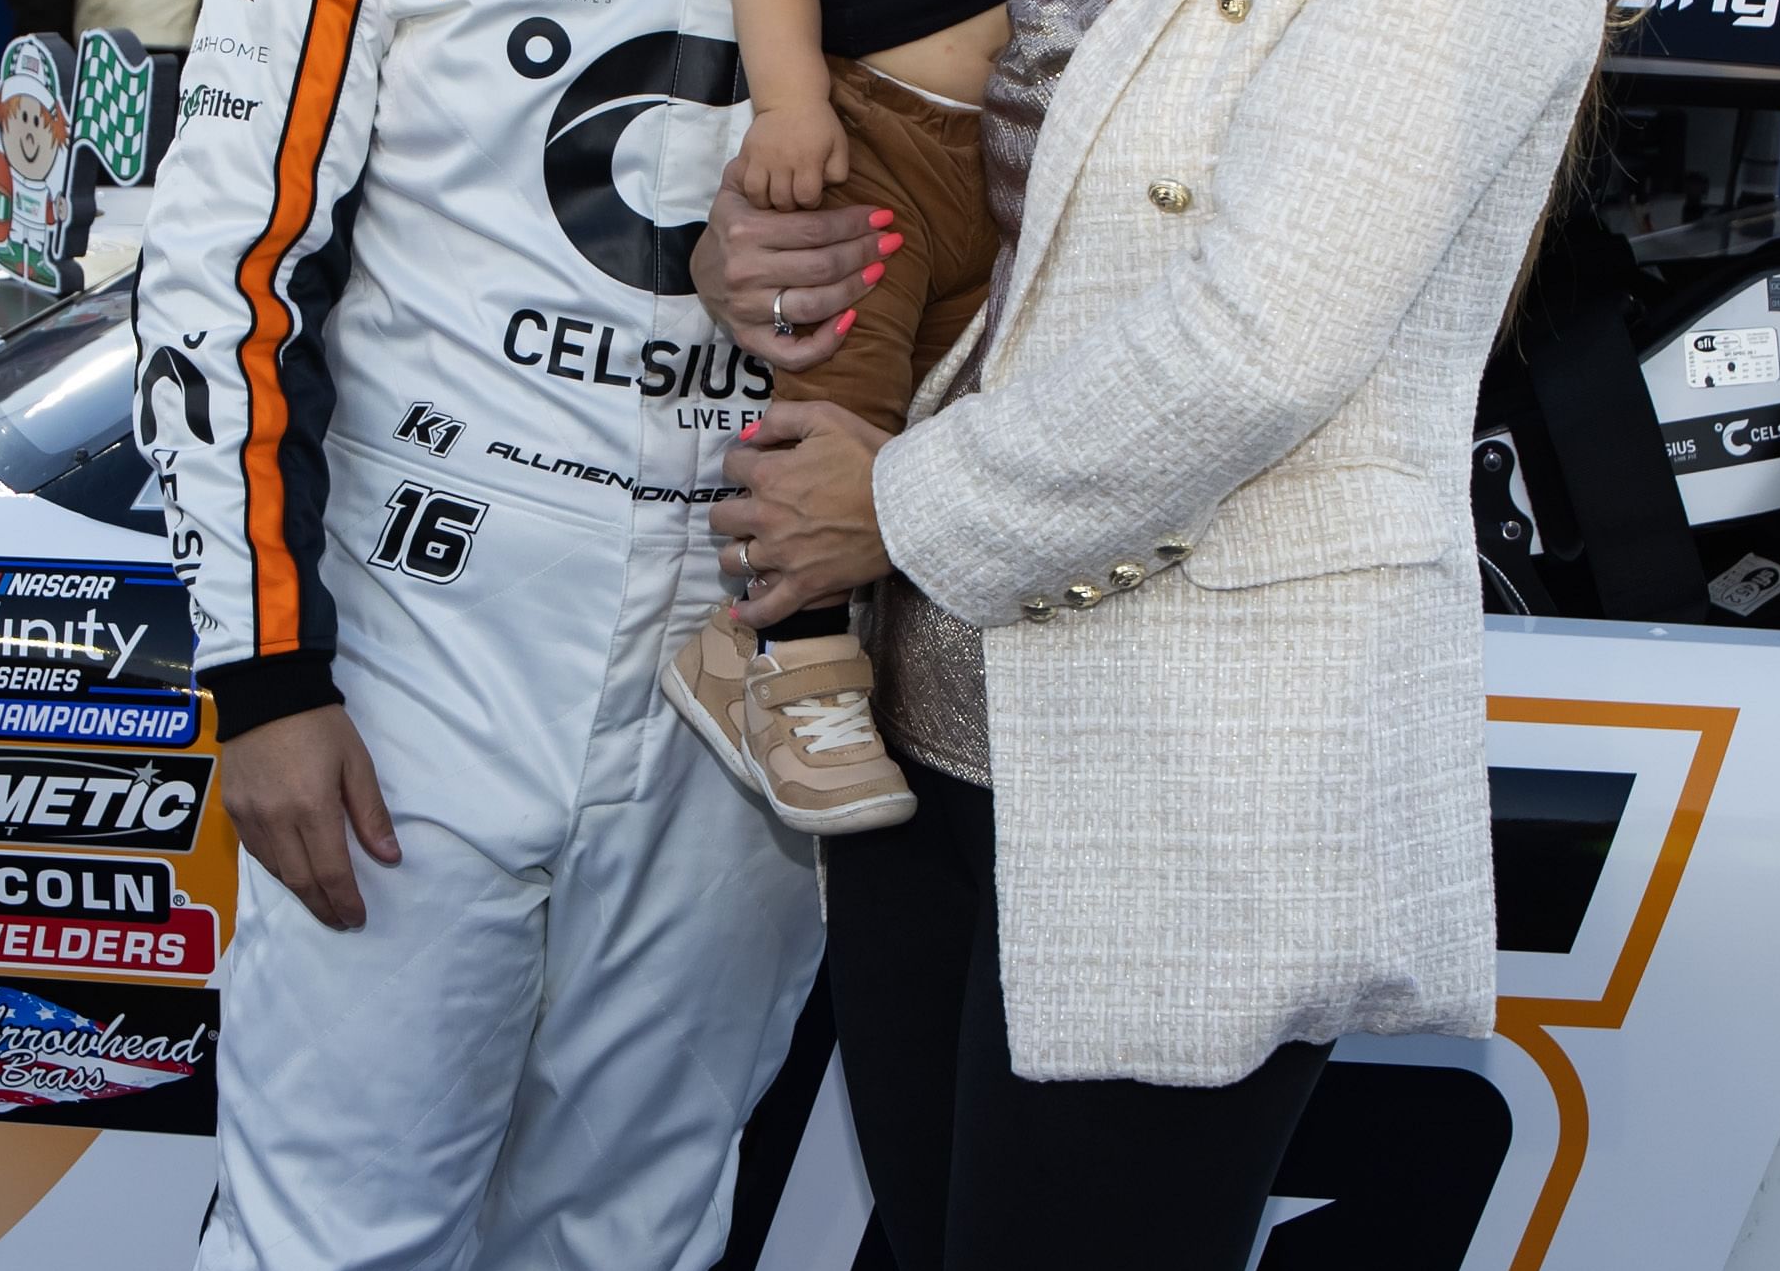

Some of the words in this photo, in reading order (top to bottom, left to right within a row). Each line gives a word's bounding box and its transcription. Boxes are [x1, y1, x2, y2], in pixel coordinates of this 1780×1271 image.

[503, 308, 773, 402] CELSIUS
[395, 401, 465, 459] K1
[677, 408, 732, 430] LIVE
[366, 478, 490, 581] 16
[7, 573, 116, 600] NASCAR
